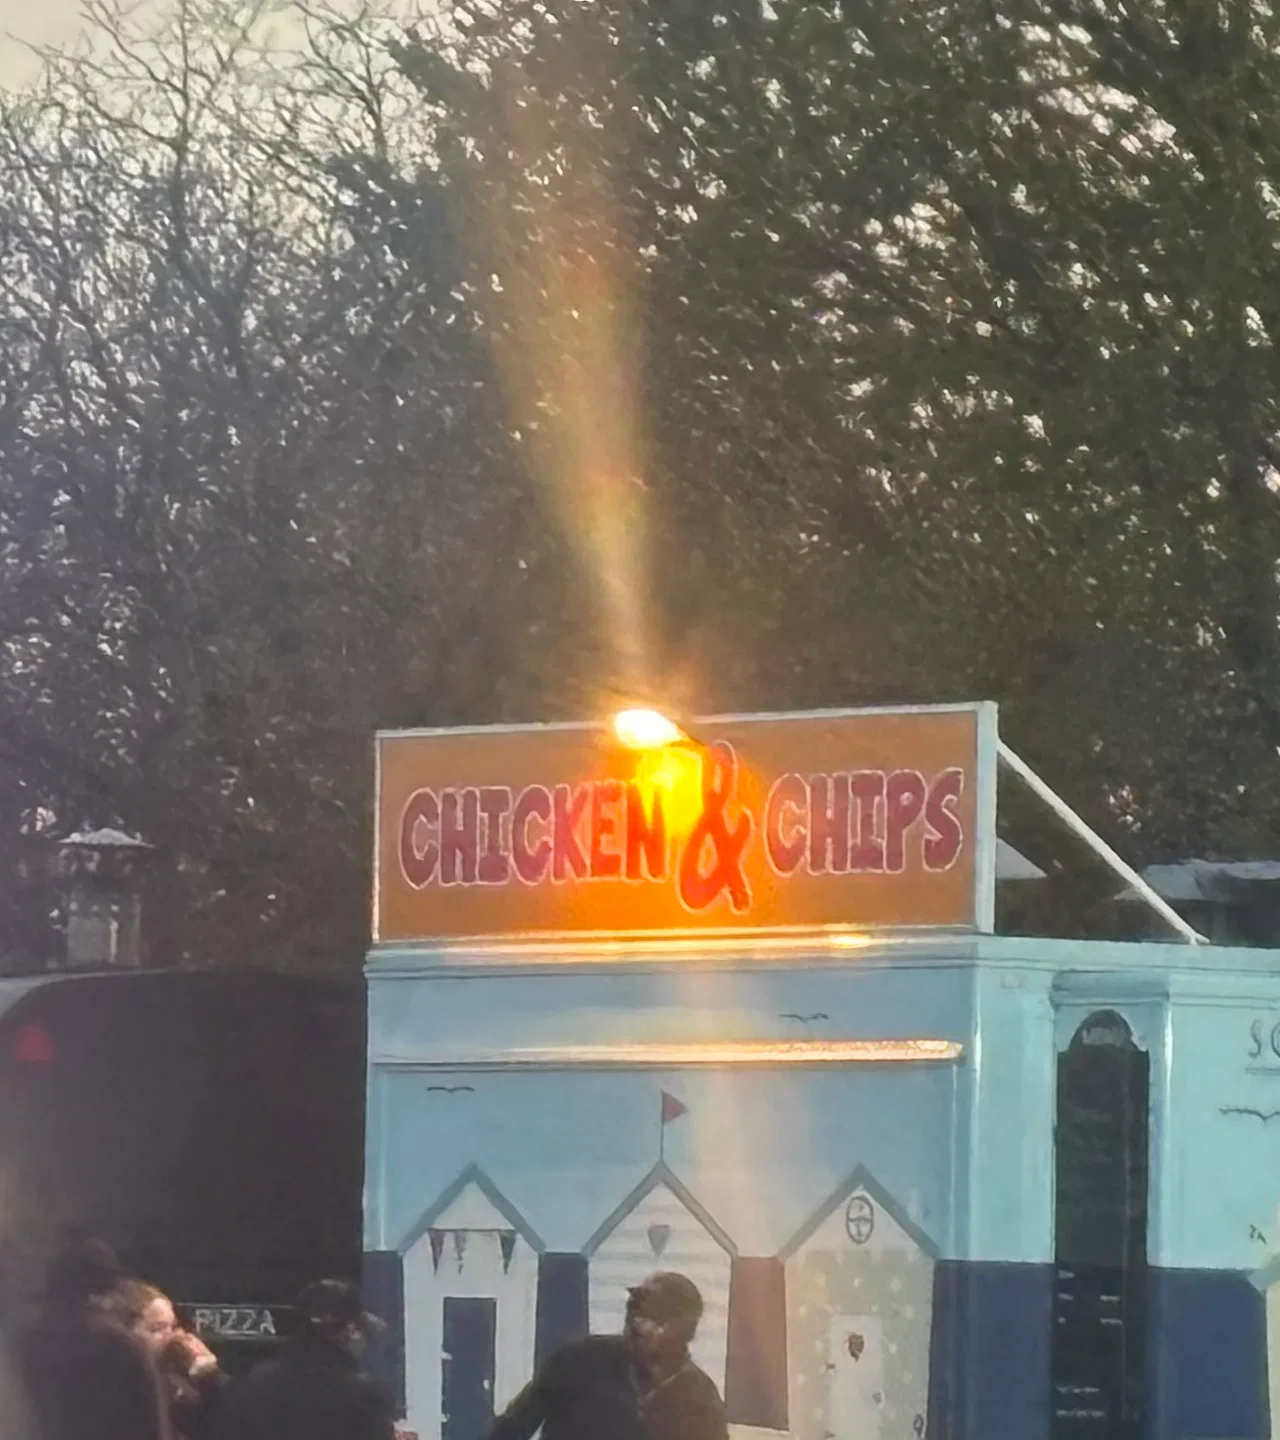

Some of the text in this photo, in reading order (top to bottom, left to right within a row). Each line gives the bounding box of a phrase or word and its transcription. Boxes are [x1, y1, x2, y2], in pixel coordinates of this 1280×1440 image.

[400, 739, 964, 913] CHICKEN & CHIPS
[194, 1307, 277, 1335] PIZZA
